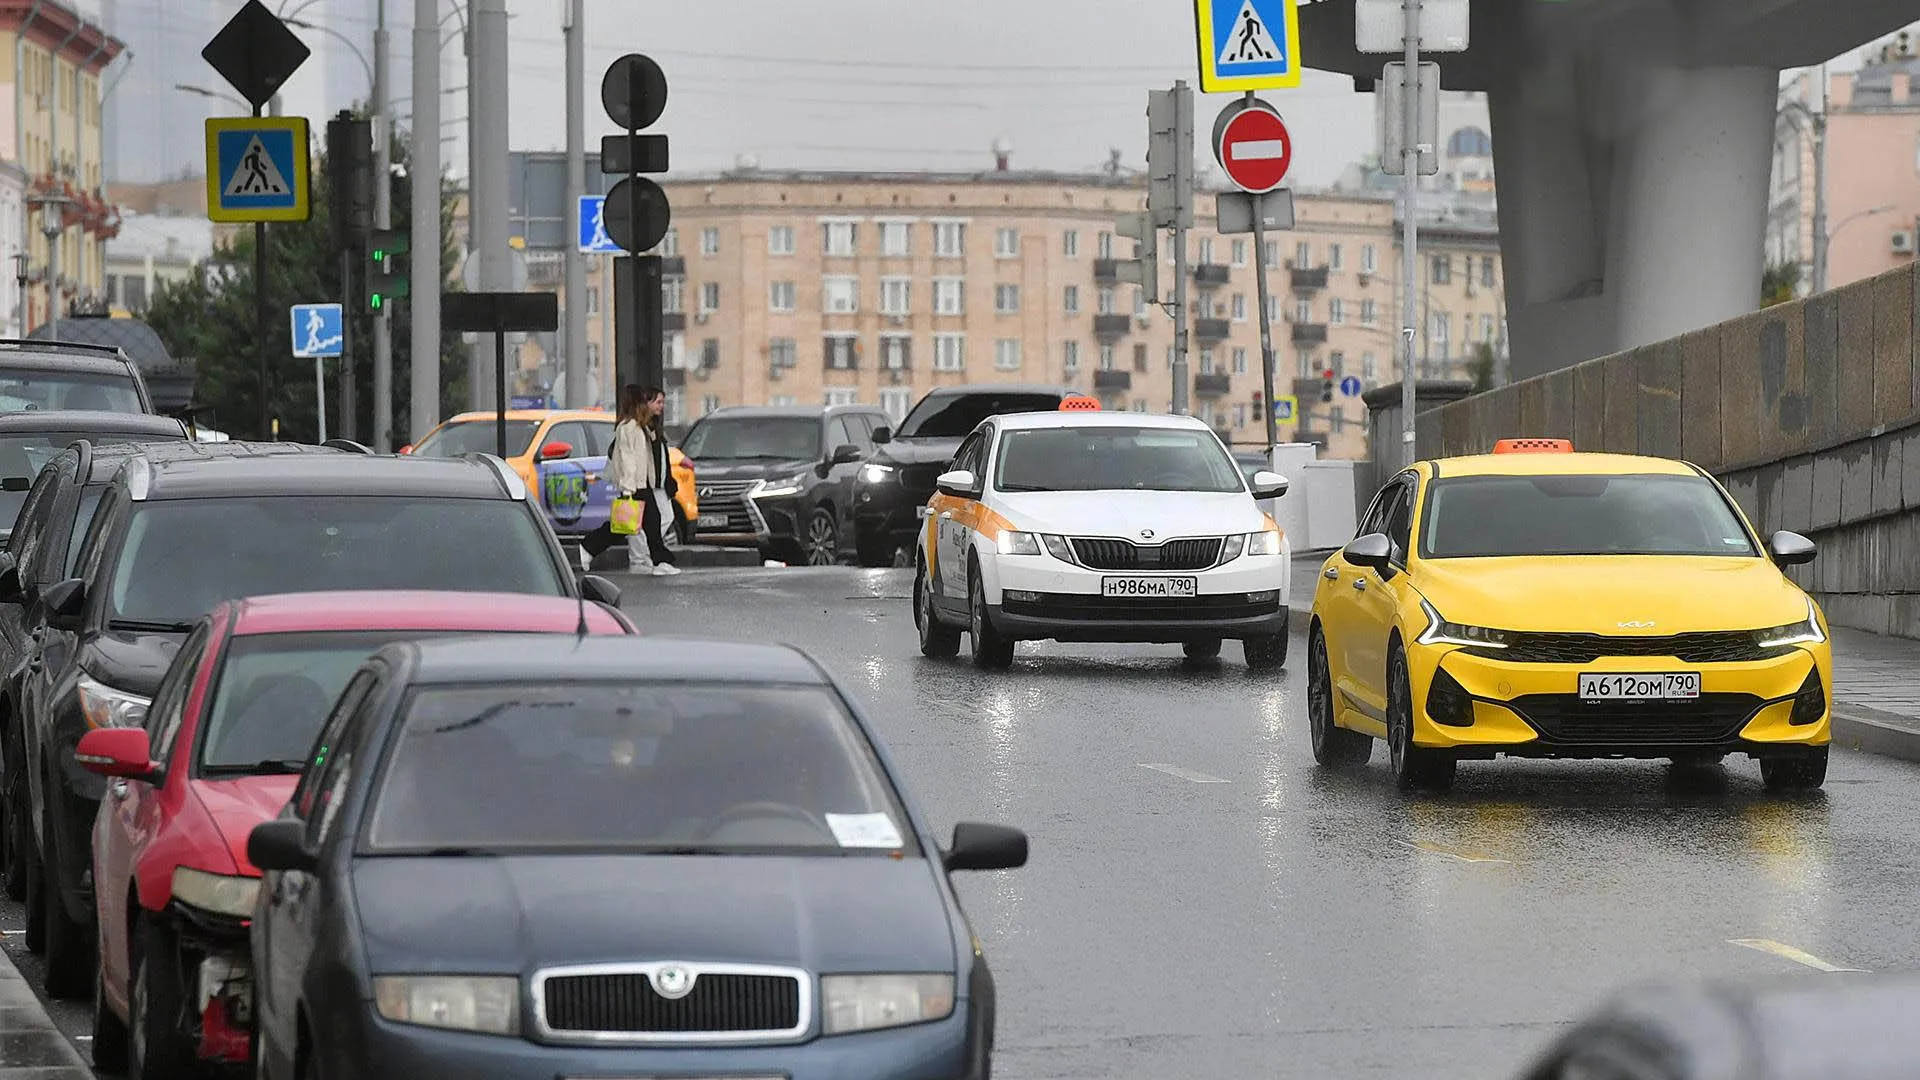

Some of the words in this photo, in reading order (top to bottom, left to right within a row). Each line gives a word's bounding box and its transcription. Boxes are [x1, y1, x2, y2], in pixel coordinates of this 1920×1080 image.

[1108, 579, 1166, 594] Н986МА
[1169, 579, 1191, 590] 790
[1586, 677, 1662, 696] А612ОМ
[1666, 675, 1695, 690] 790
